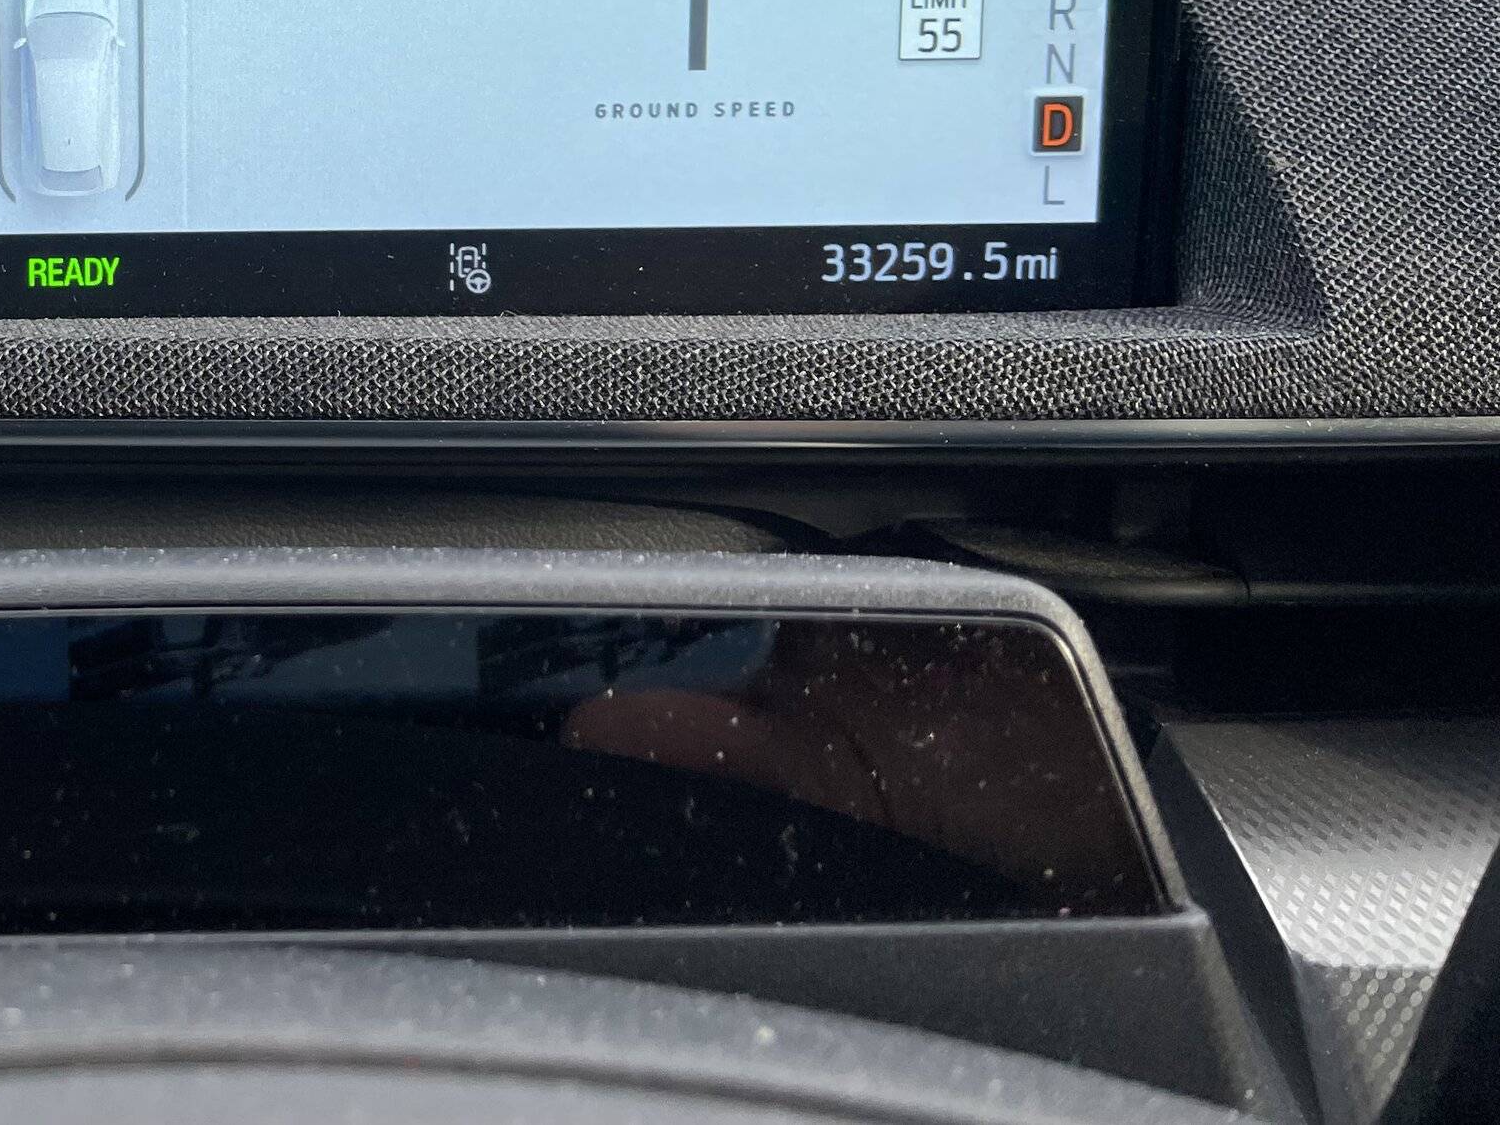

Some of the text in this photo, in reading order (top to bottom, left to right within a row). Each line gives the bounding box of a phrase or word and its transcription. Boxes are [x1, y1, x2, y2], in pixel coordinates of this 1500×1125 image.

[917, 18, 963, 53] 55
[1045, 43, 1076, 85] N
[595, 101, 796, 119] GROUND SPEED
[1041, 103, 1075, 147] D
[1043, 165, 1065, 206] L
[28, 257, 120, 287] READY
